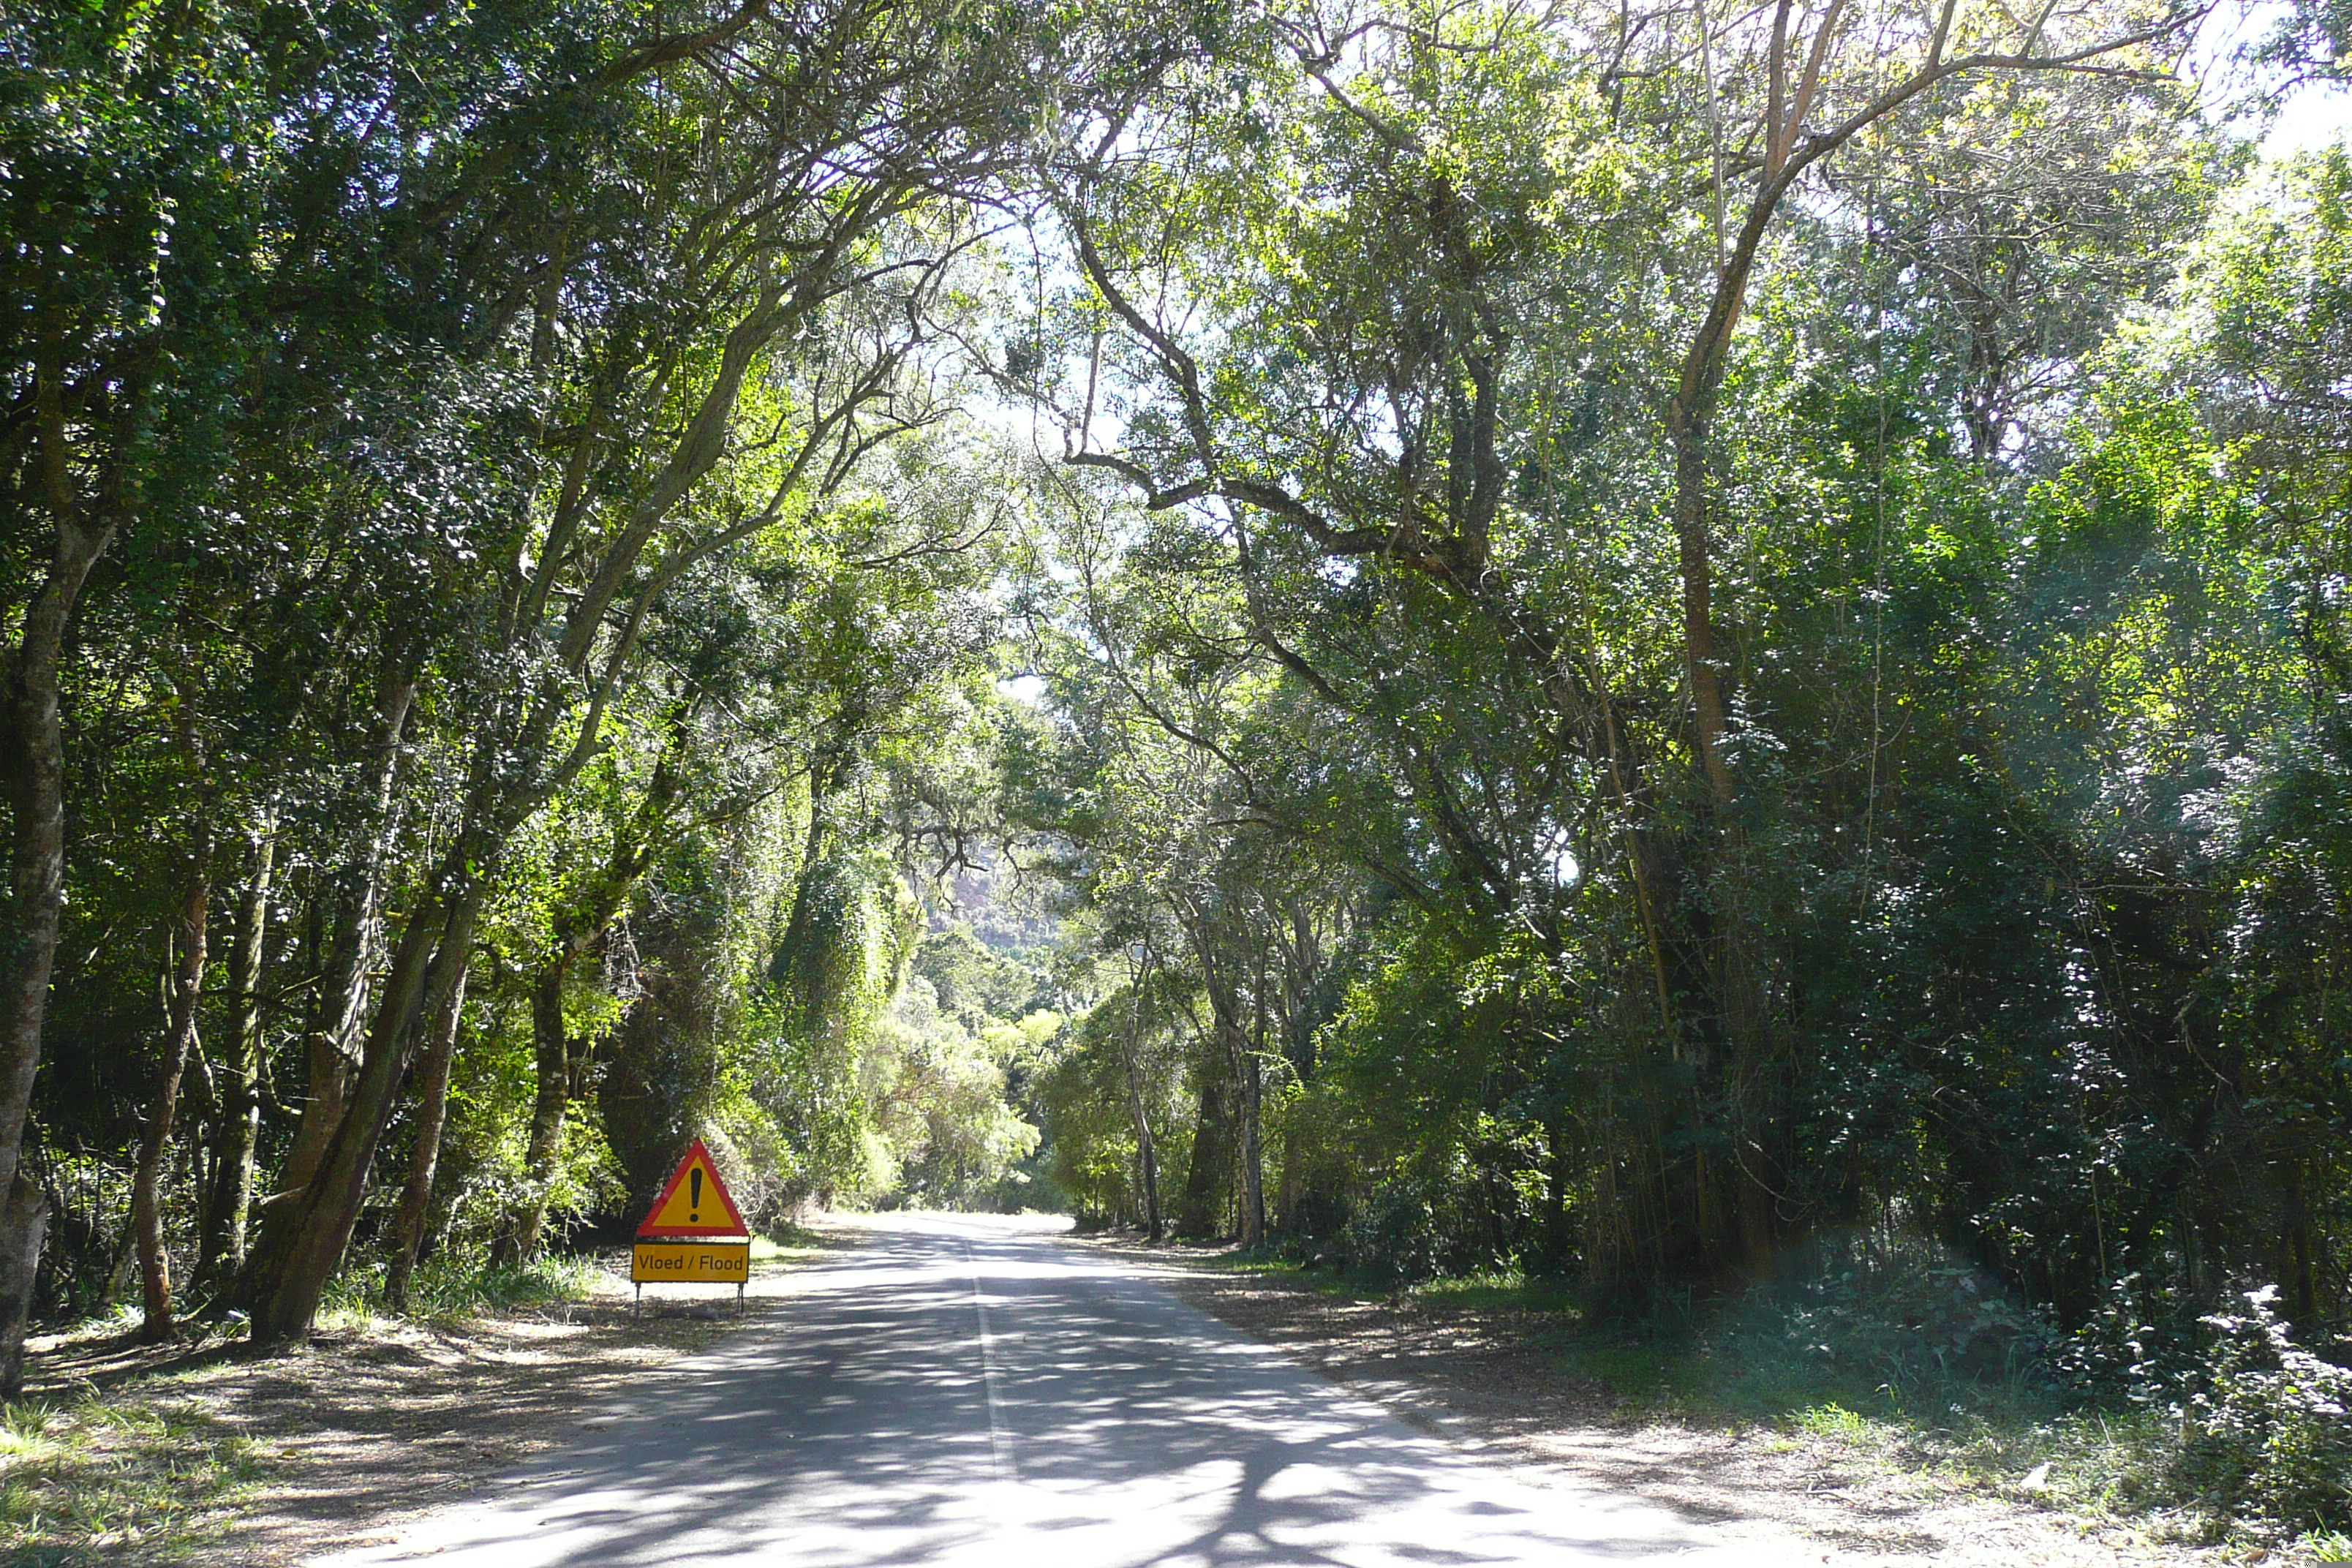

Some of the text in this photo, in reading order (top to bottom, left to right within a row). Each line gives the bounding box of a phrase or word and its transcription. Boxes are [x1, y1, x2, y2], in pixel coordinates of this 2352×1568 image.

[639, 1255, 743, 1270] Vloed / Flood
